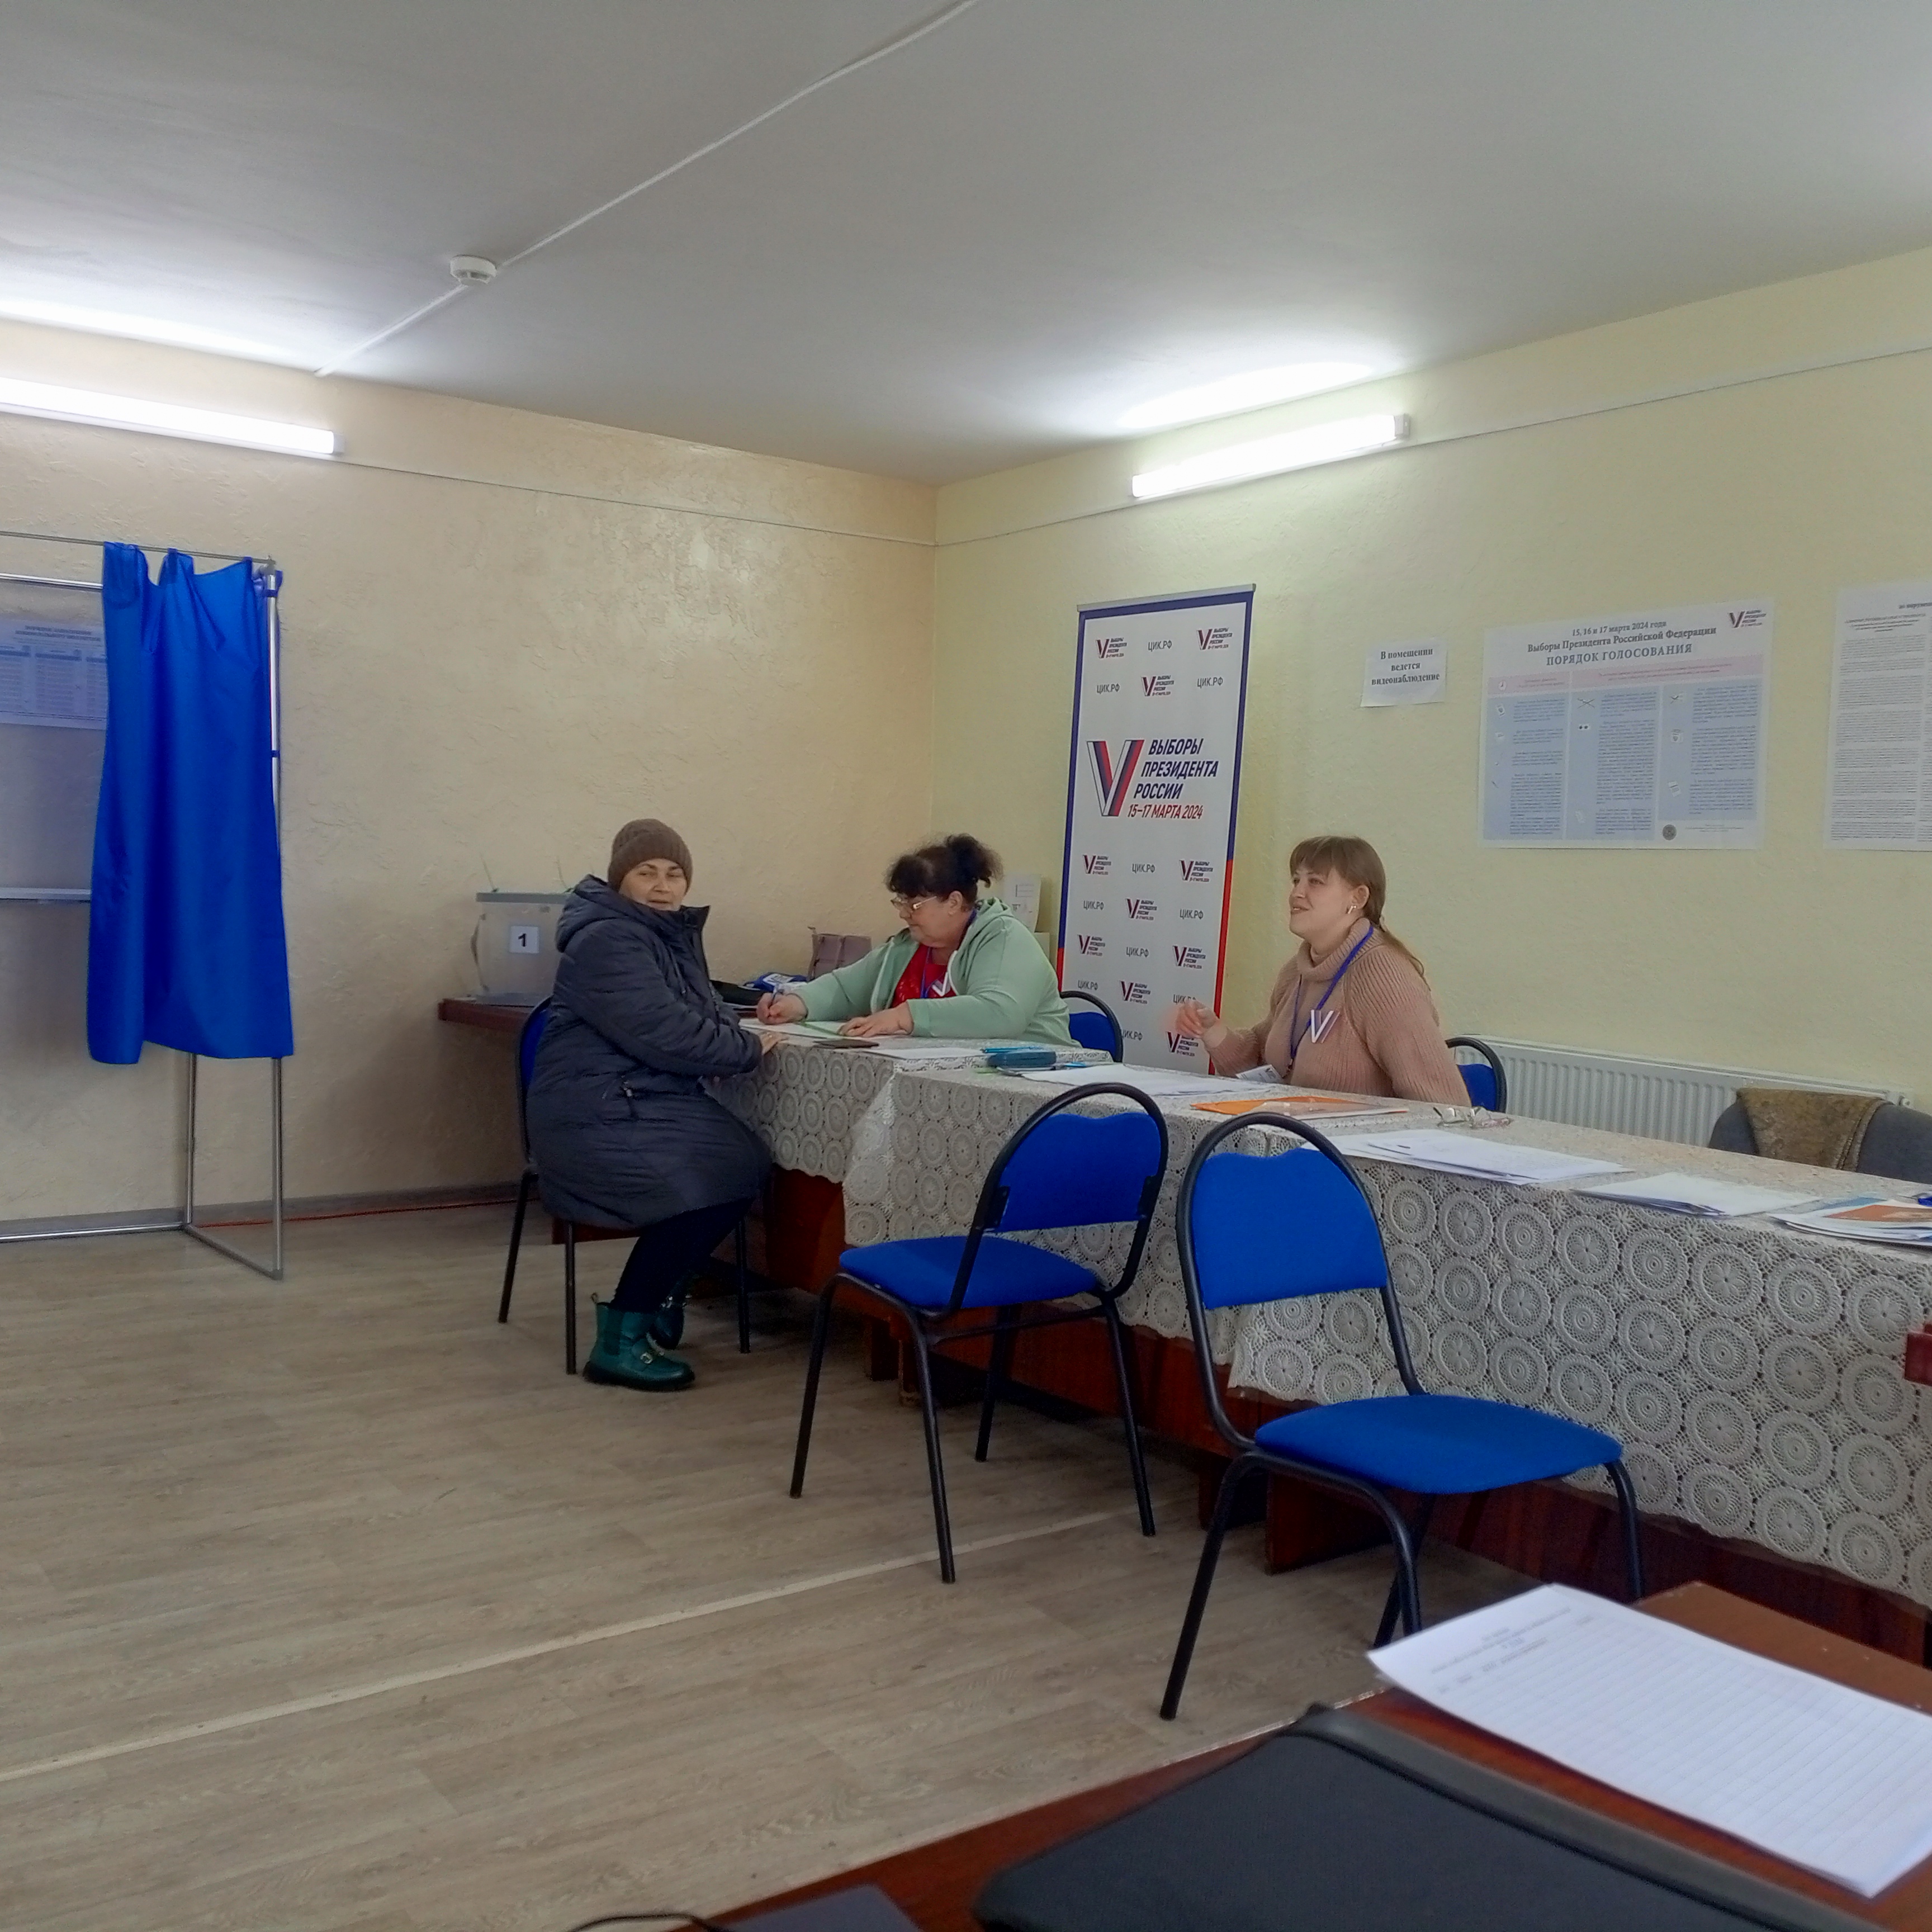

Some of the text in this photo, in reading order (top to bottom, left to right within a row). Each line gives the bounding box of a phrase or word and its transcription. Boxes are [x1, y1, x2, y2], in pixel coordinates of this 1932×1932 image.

[1572, 628, 1581, 637] 15,
[1609, 624, 1630, 633] марта
[1631, 621, 1649, 630] 2024
[1650, 620, 1666, 629] года
[1527, 627, 1717, 652] Выборы Президента Российской Федерации
[1148, 640, 1172, 652] ЦИК.РФ
[1380, 648, 1433, 660] В помещении
[1546, 643, 1693, 665] ПОРЯДОК ГОЛОСОВАНИЯ
[1391, 662, 1420, 671] ведется
[1197, 676, 1223, 689] ЦИК.РФ
[1371, 673, 1440, 685] видеонаблюдение
[1096, 683, 1120, 694] ЦИК.РФ
[1148, 738, 1204, 755] ВЫБОРЫ
[1140, 760, 1219, 779] ПРЕЗИДЕНТА
[1133, 783, 1183, 799] РОССИИ
[1151, 804, 1181, 819] МАРТА
[1181, 805, 1204, 819] 2024
[1132, 863, 1156, 874] ЦИК.РФ
[1083, 900, 1105, 911] ЦИК.РФ
[1179, 908, 1204, 920] ЦИК.РФ
[518, 932, 527, 947] 1
[1126, 946, 1149, 958] ЦИК.РФ
[1077, 979, 1098, 991] ЦИК.РФ
